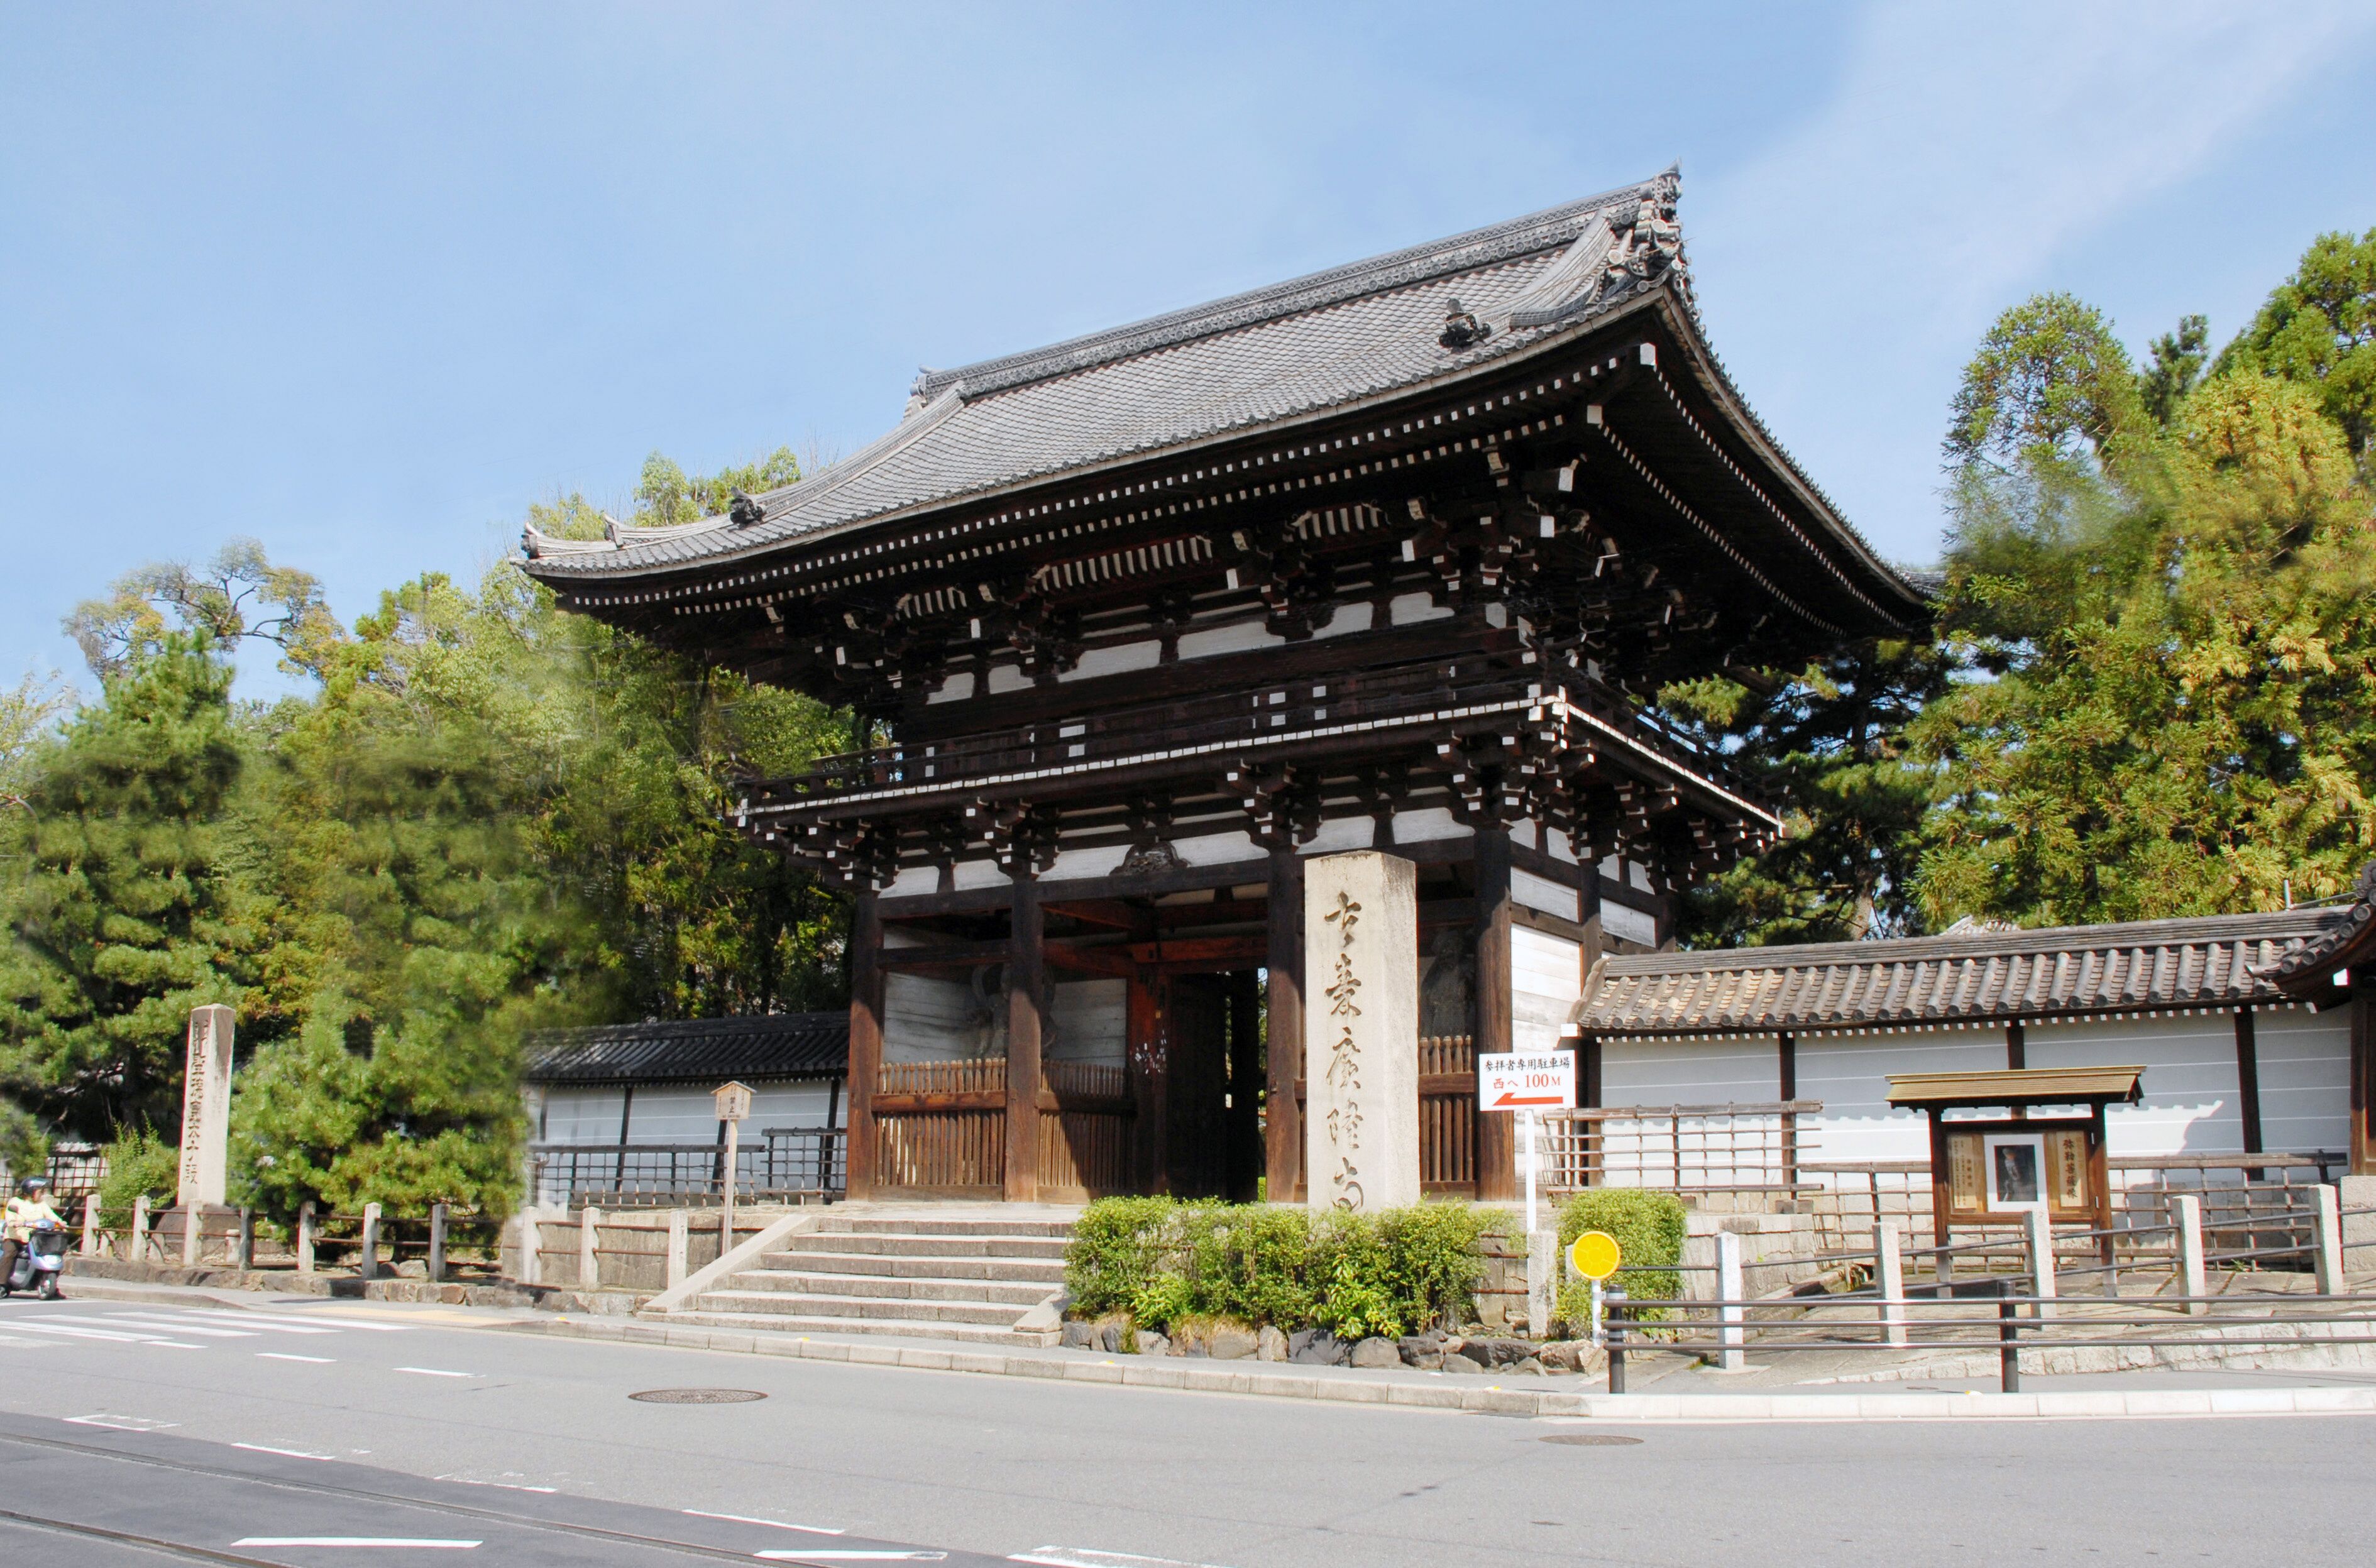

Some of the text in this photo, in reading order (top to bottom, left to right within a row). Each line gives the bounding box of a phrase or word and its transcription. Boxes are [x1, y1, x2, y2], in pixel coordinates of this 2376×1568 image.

[1485, 1057, 1570, 1072] 参拝者専用駐車場
